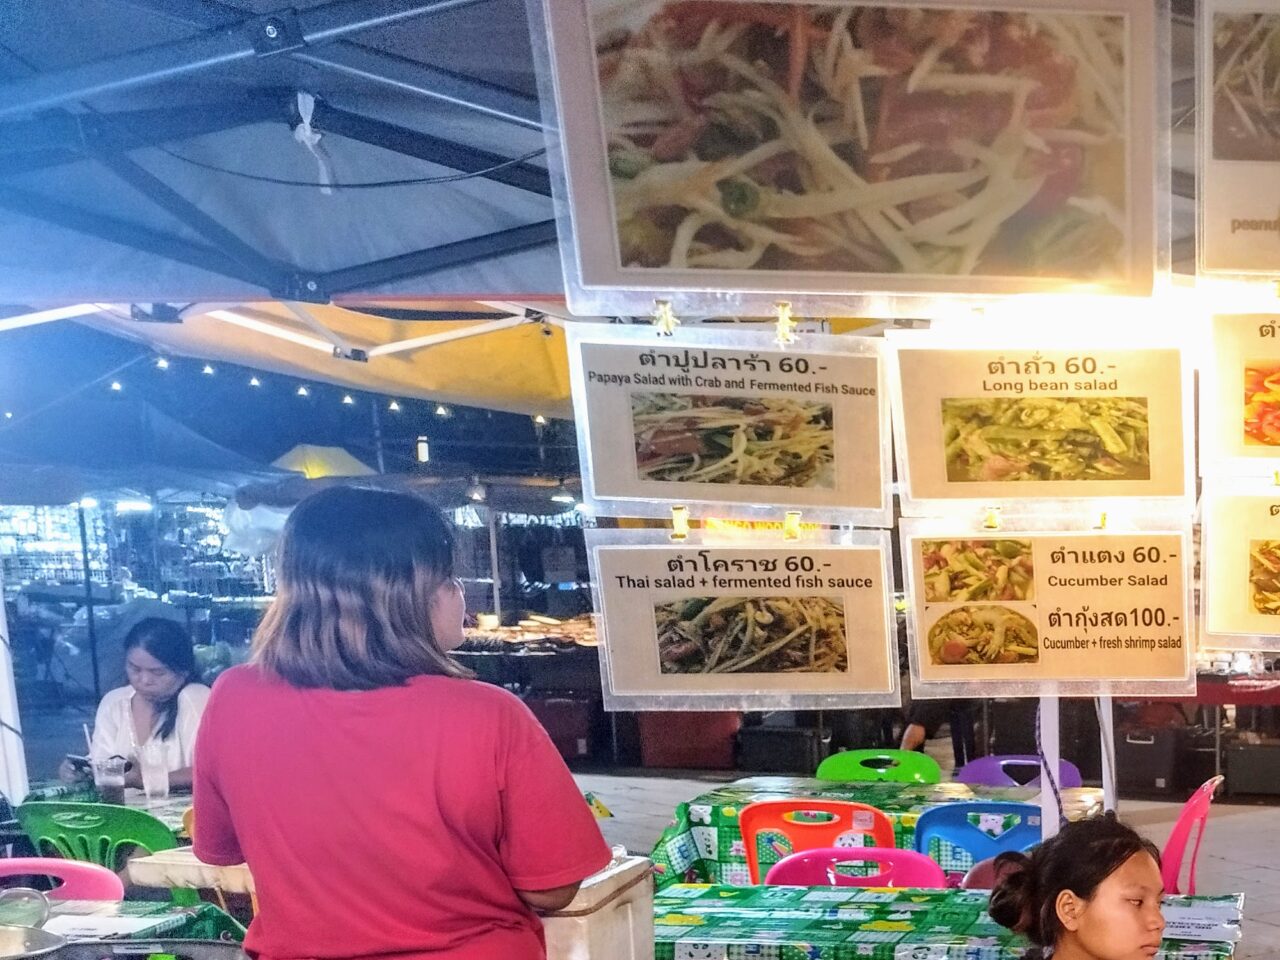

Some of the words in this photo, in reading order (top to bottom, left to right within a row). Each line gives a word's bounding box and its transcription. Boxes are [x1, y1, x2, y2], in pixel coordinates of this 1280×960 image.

[779, 357, 828, 375] 60.-
[1065, 356, 1117, 376] 60.-
[588, 371, 631, 385] Papaya
[634, 373, 666, 386] Salad
[669, 374, 693, 387] with
[695, 376, 722, 389] Crab
[724, 377, 745, 389] and
[750, 379, 812, 393] Fermented
[815, 382, 839, 395] Fish
[841, 384, 876, 396] Sauce
[983, 379, 1023, 394] Long
[1029, 379, 1069, 391] bean
[1075, 379, 1118, 391] salad
[667, 550, 777, 572] ตำโคราช
[785, 556, 832, 573] 60.-
[1050, 547, 1125, 565] ตำแตง
[1133, 546, 1178, 564] 60.-
[616, 575, 650, 588] Thai
[654, 575, 695, 589] salad
[700, 579, 708, 587] +
[713, 575, 791, 589] fermented
[795, 574, 823, 589] fish
[828, 578, 873, 589] sauce
[1048, 575, 1124, 587] Cucumber
[1128, 574, 1168, 587] Salad
[1043, 636, 1091, 650] Cucumber
[1099, 636, 1123, 650] fresh
[1123, 636, 1156, 651] shrimp
[1156, 636, 1182, 649] salad
